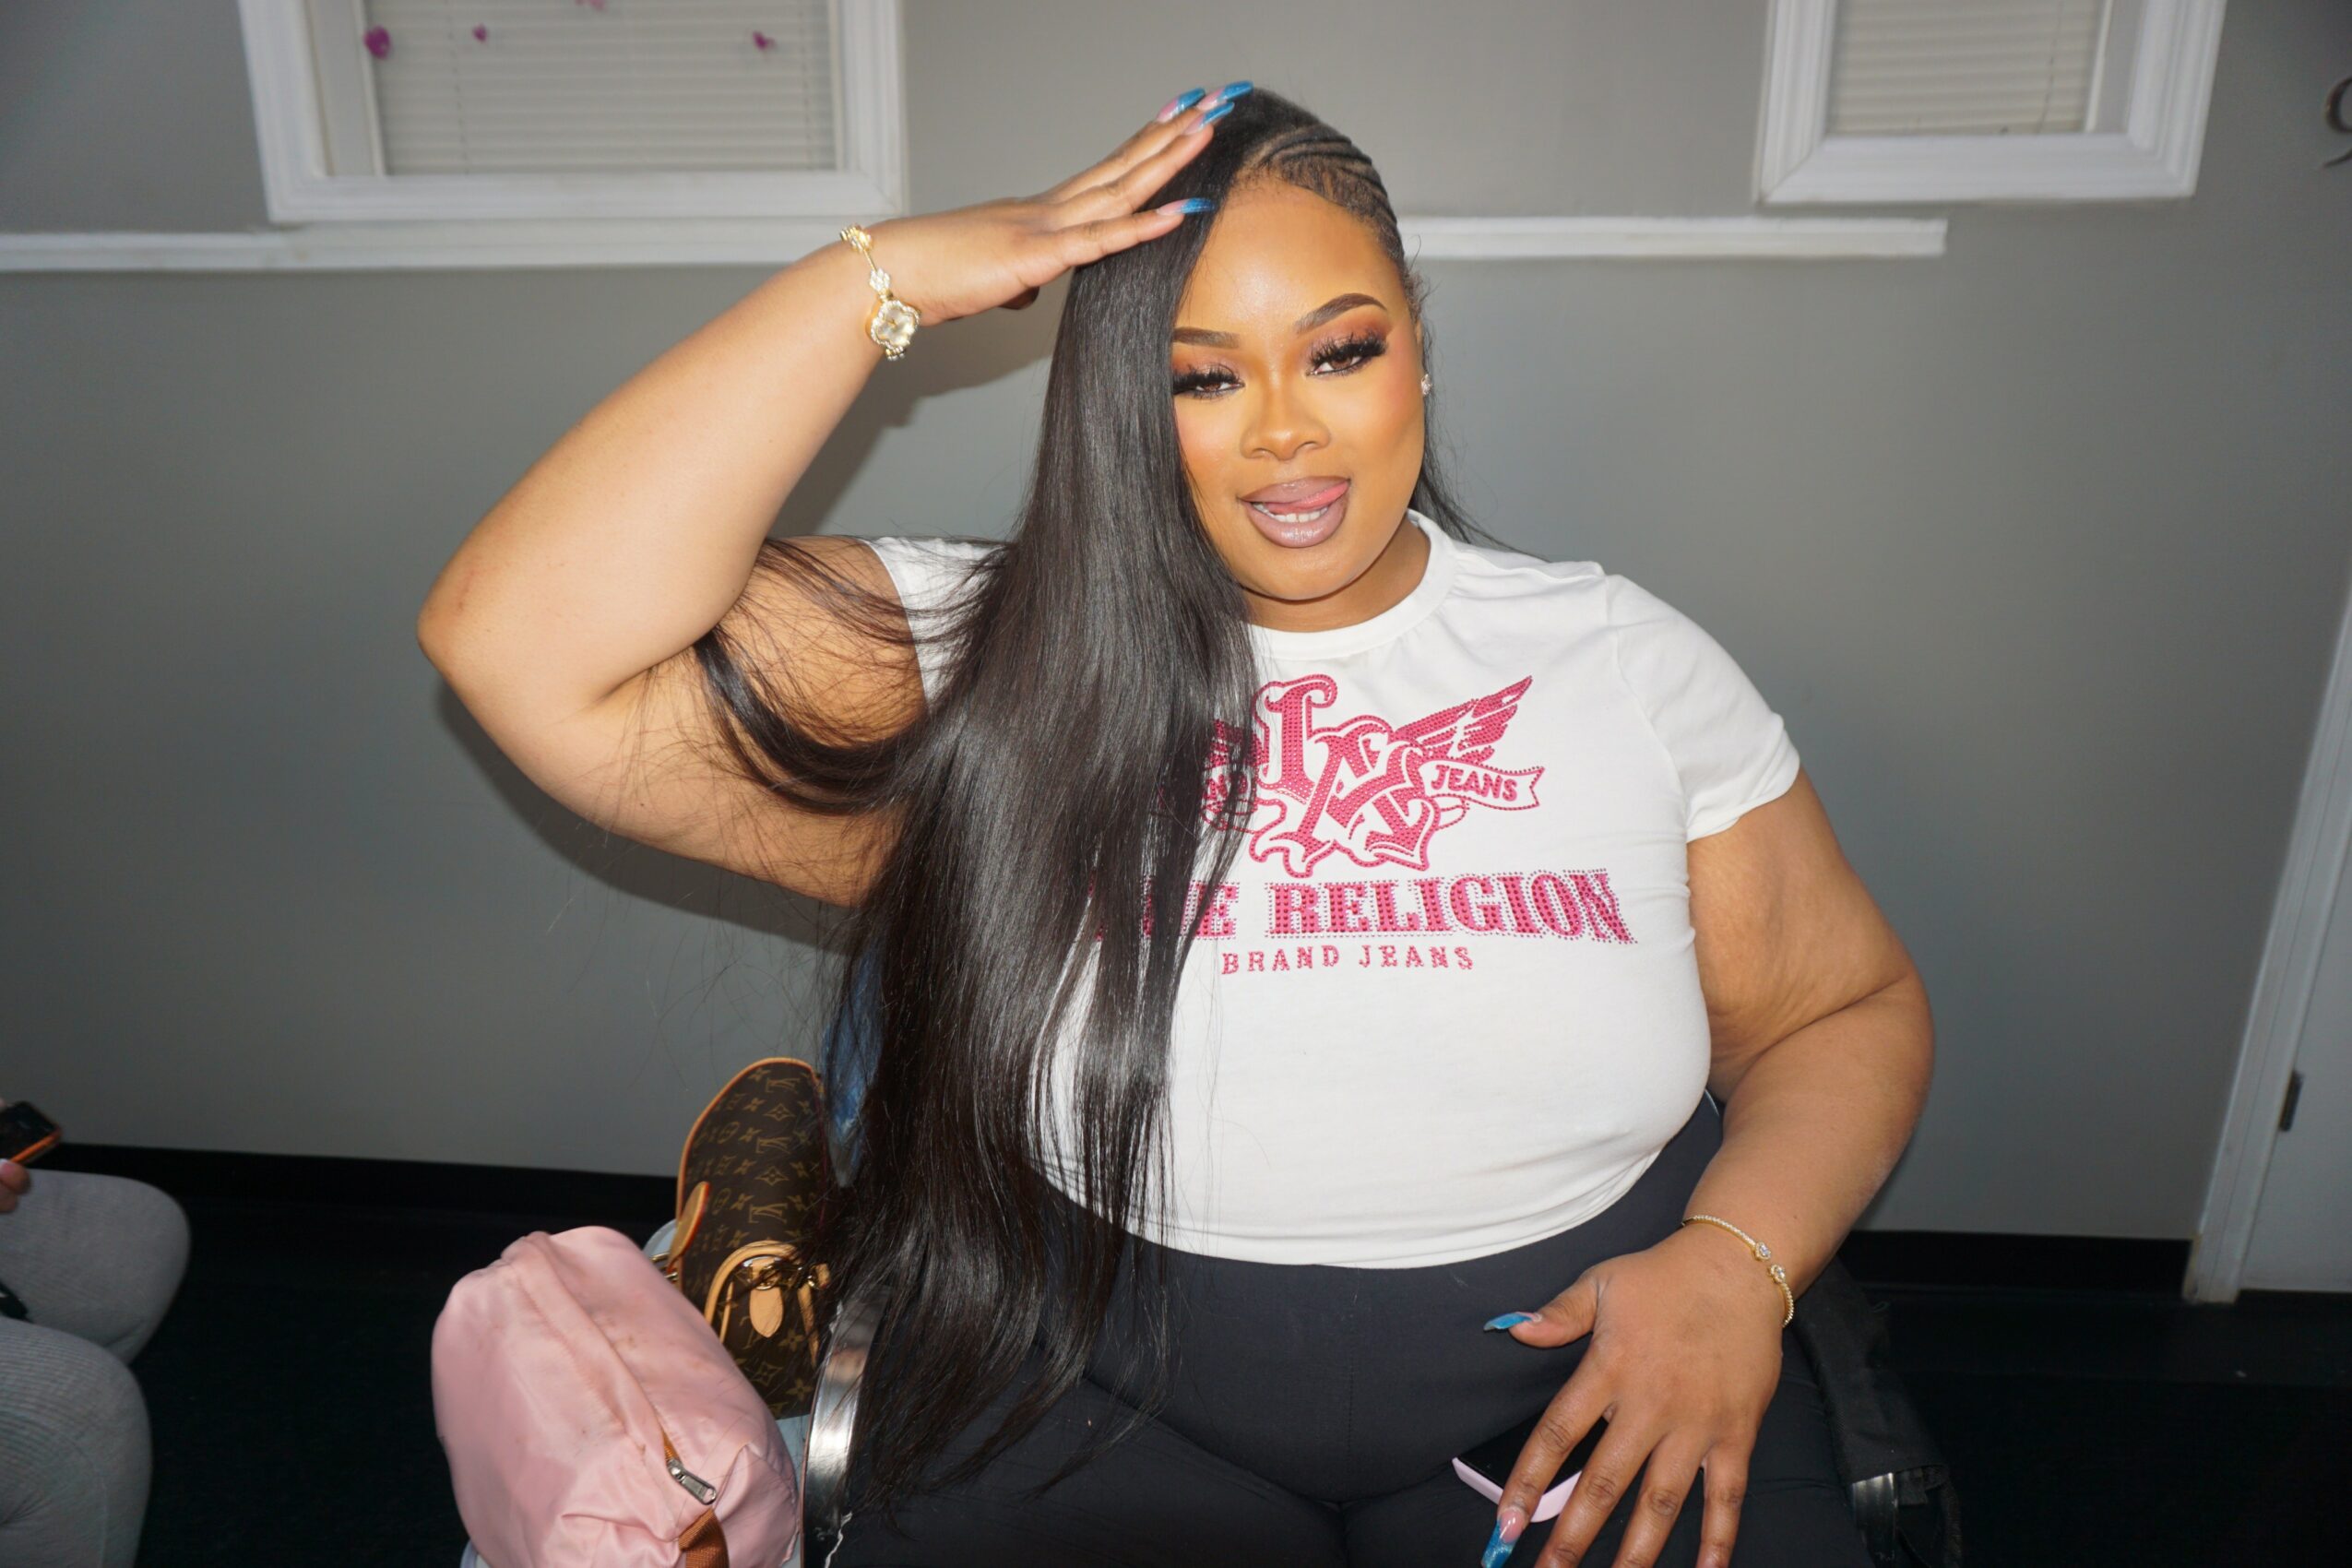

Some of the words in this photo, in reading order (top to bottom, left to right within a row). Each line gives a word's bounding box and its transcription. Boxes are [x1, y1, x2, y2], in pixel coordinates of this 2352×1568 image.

[1431, 764, 1518, 802] JEANS
[1264, 868, 1638, 944] RELIGION
[1222, 944, 1340, 975] BRAND
[1359, 944, 1474, 970] JEANS
